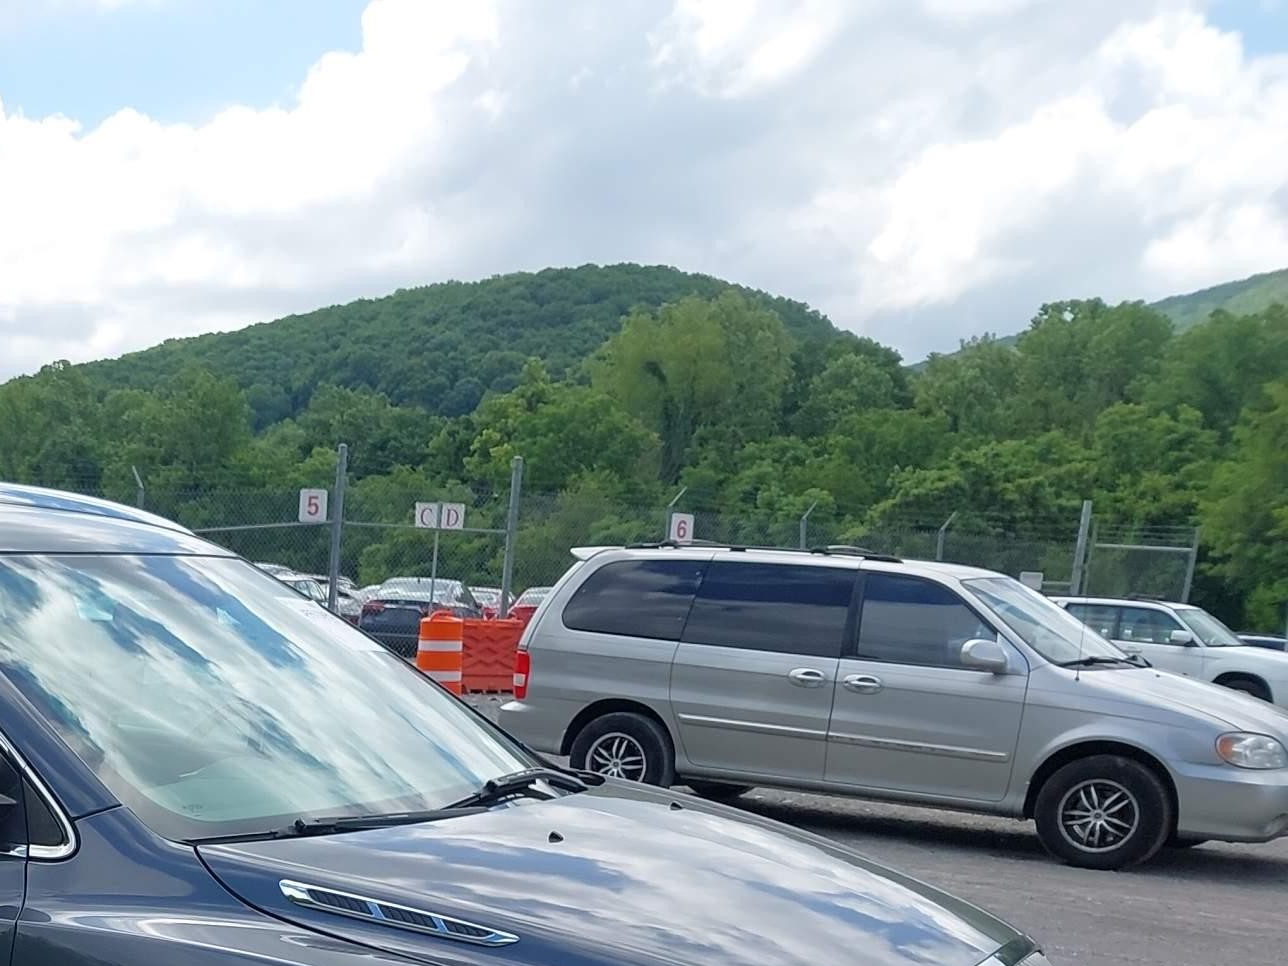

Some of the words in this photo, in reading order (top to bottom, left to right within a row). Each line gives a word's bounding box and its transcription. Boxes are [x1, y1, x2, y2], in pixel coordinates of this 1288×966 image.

[307, 496, 319, 516] 5
[420, 508, 433, 526] C
[446, 508, 460, 527] D
[677, 519, 687, 538] 6
